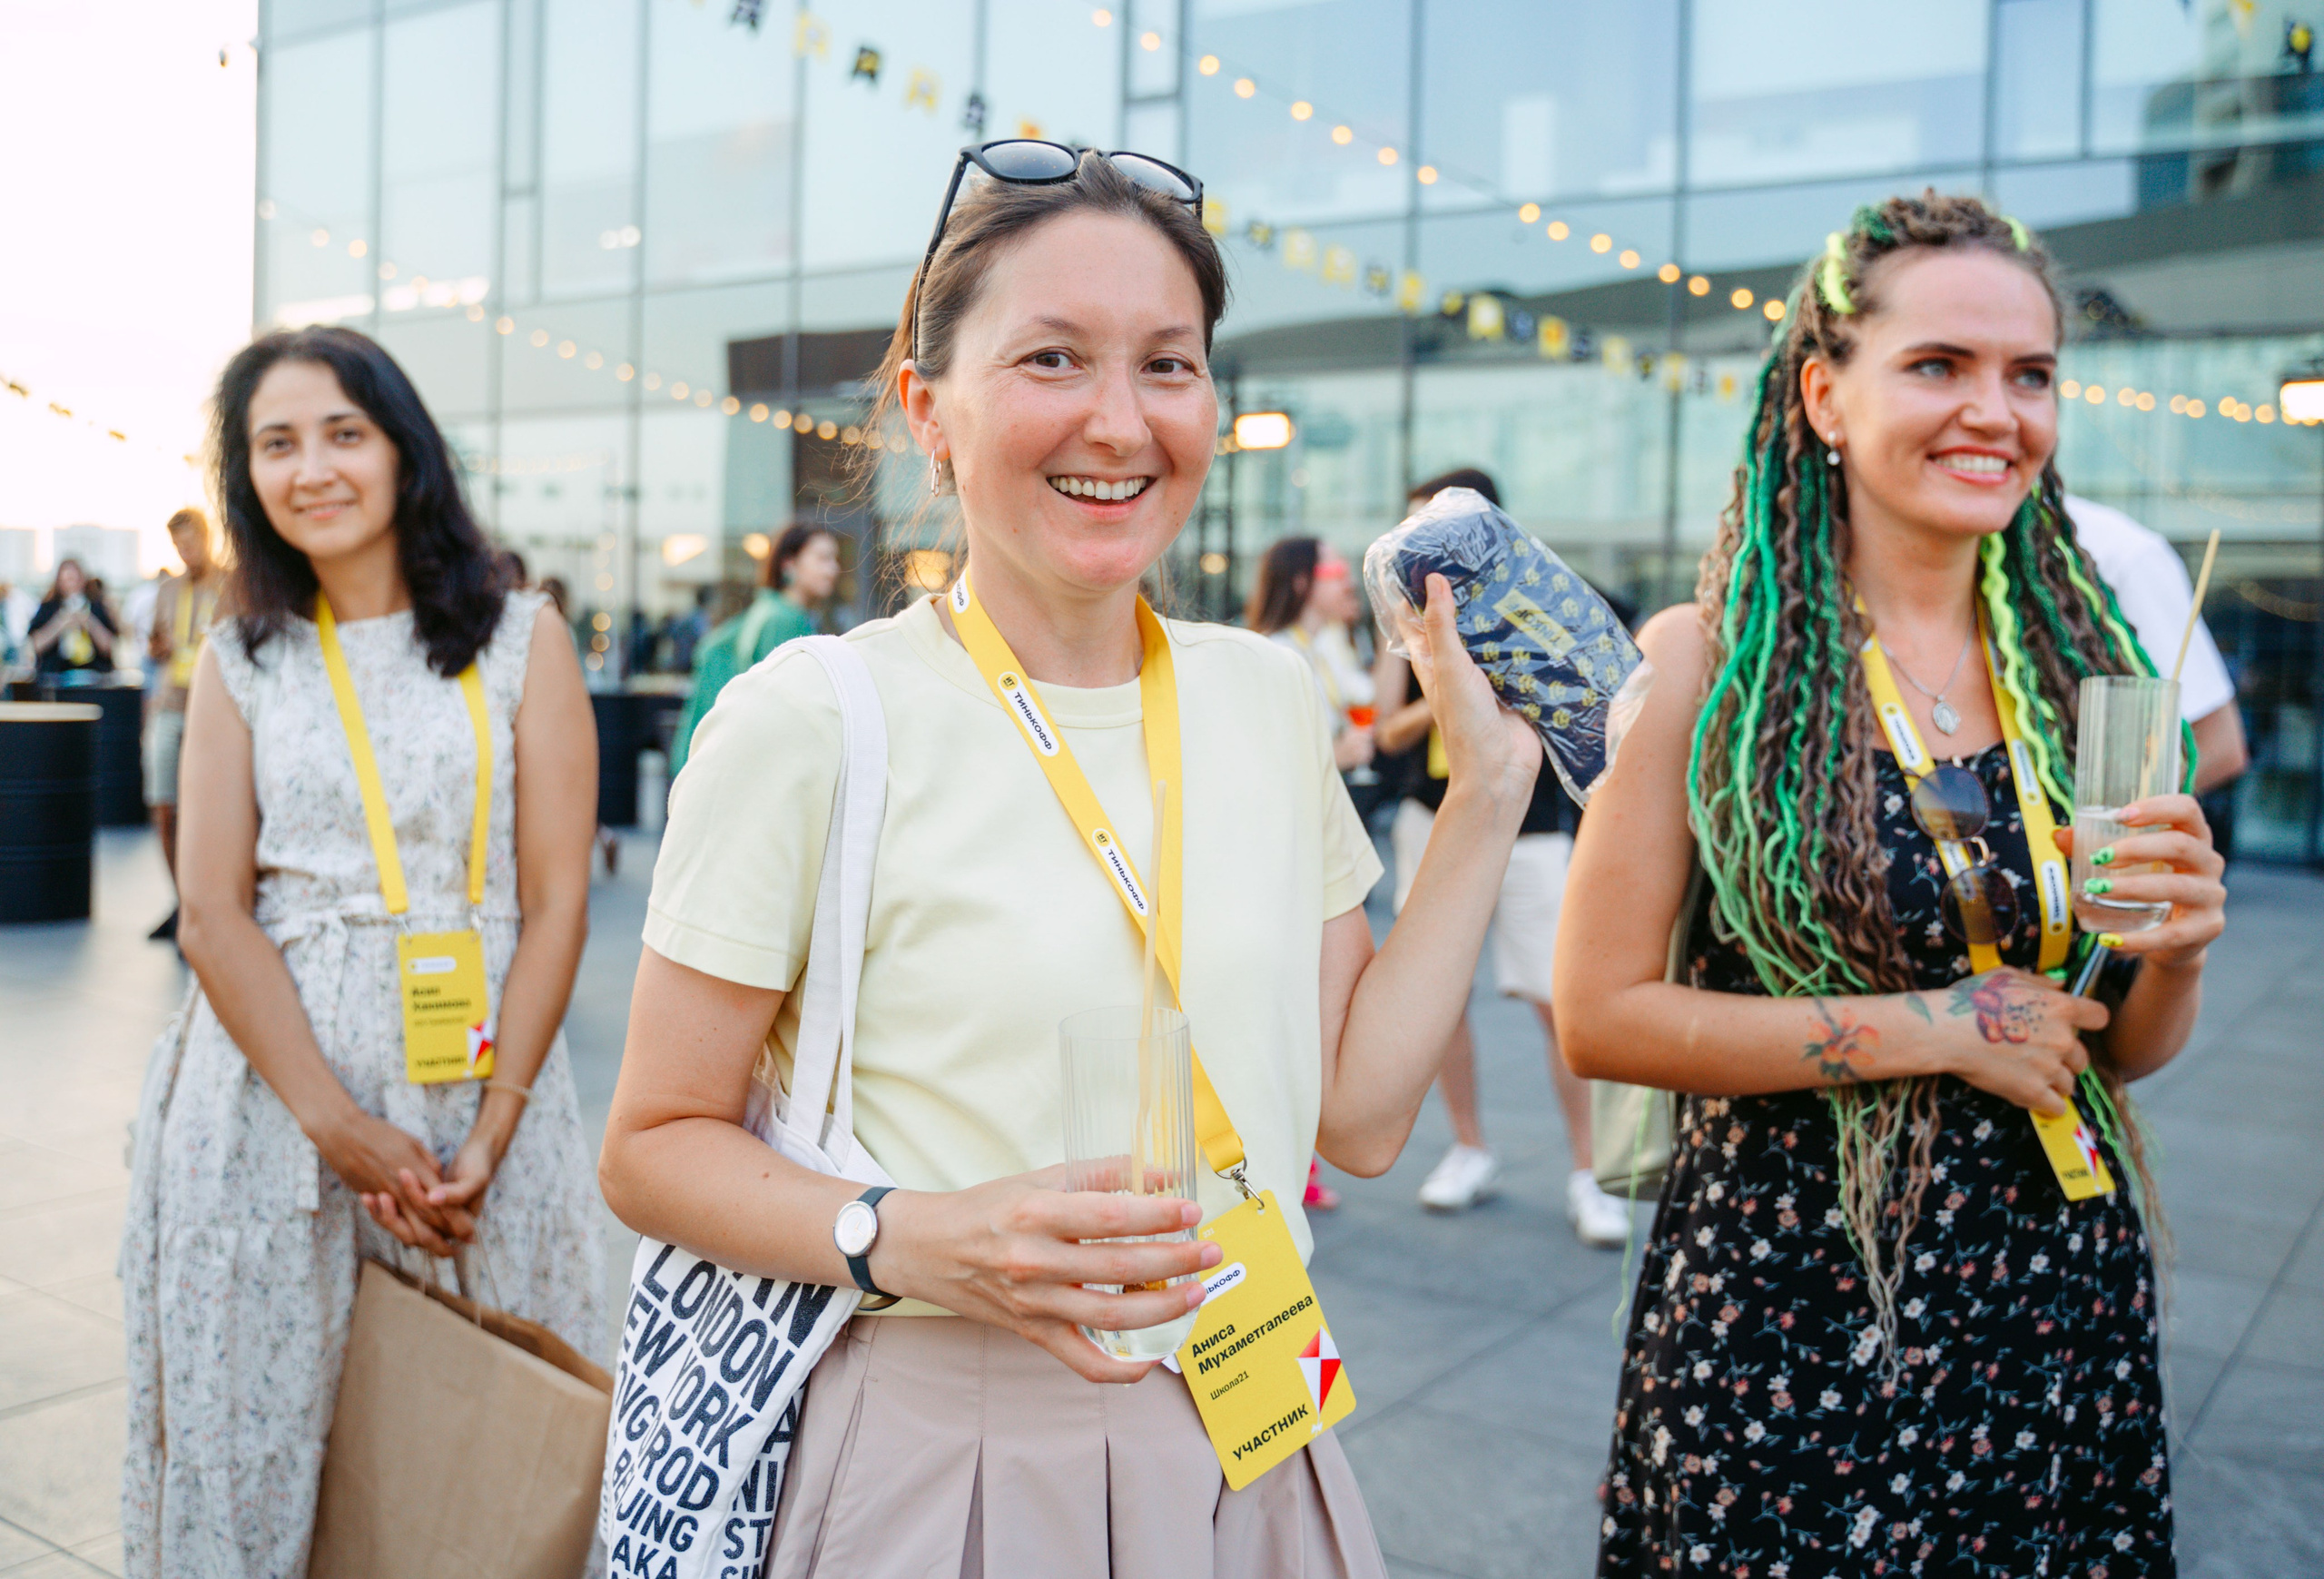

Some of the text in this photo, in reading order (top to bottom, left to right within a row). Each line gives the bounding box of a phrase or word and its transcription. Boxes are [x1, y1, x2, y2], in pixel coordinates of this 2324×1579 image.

[1014, 692, 1052, 750] ТИНЬКОФФ
[1108, 849, 1144, 910] ТИНЬКОФФ
[642, 1244, 795, 1412] LONDON
[1192, 1324, 1236, 1357] Аниса
[1198, 1295, 1314, 1375] Мухаметгалеева
[623, 1282, 755, 1469] EW YORK
[1210, 1371, 1249, 1400] Школа21
[1232, 1403, 1309, 1461] УЧАСТНИК
